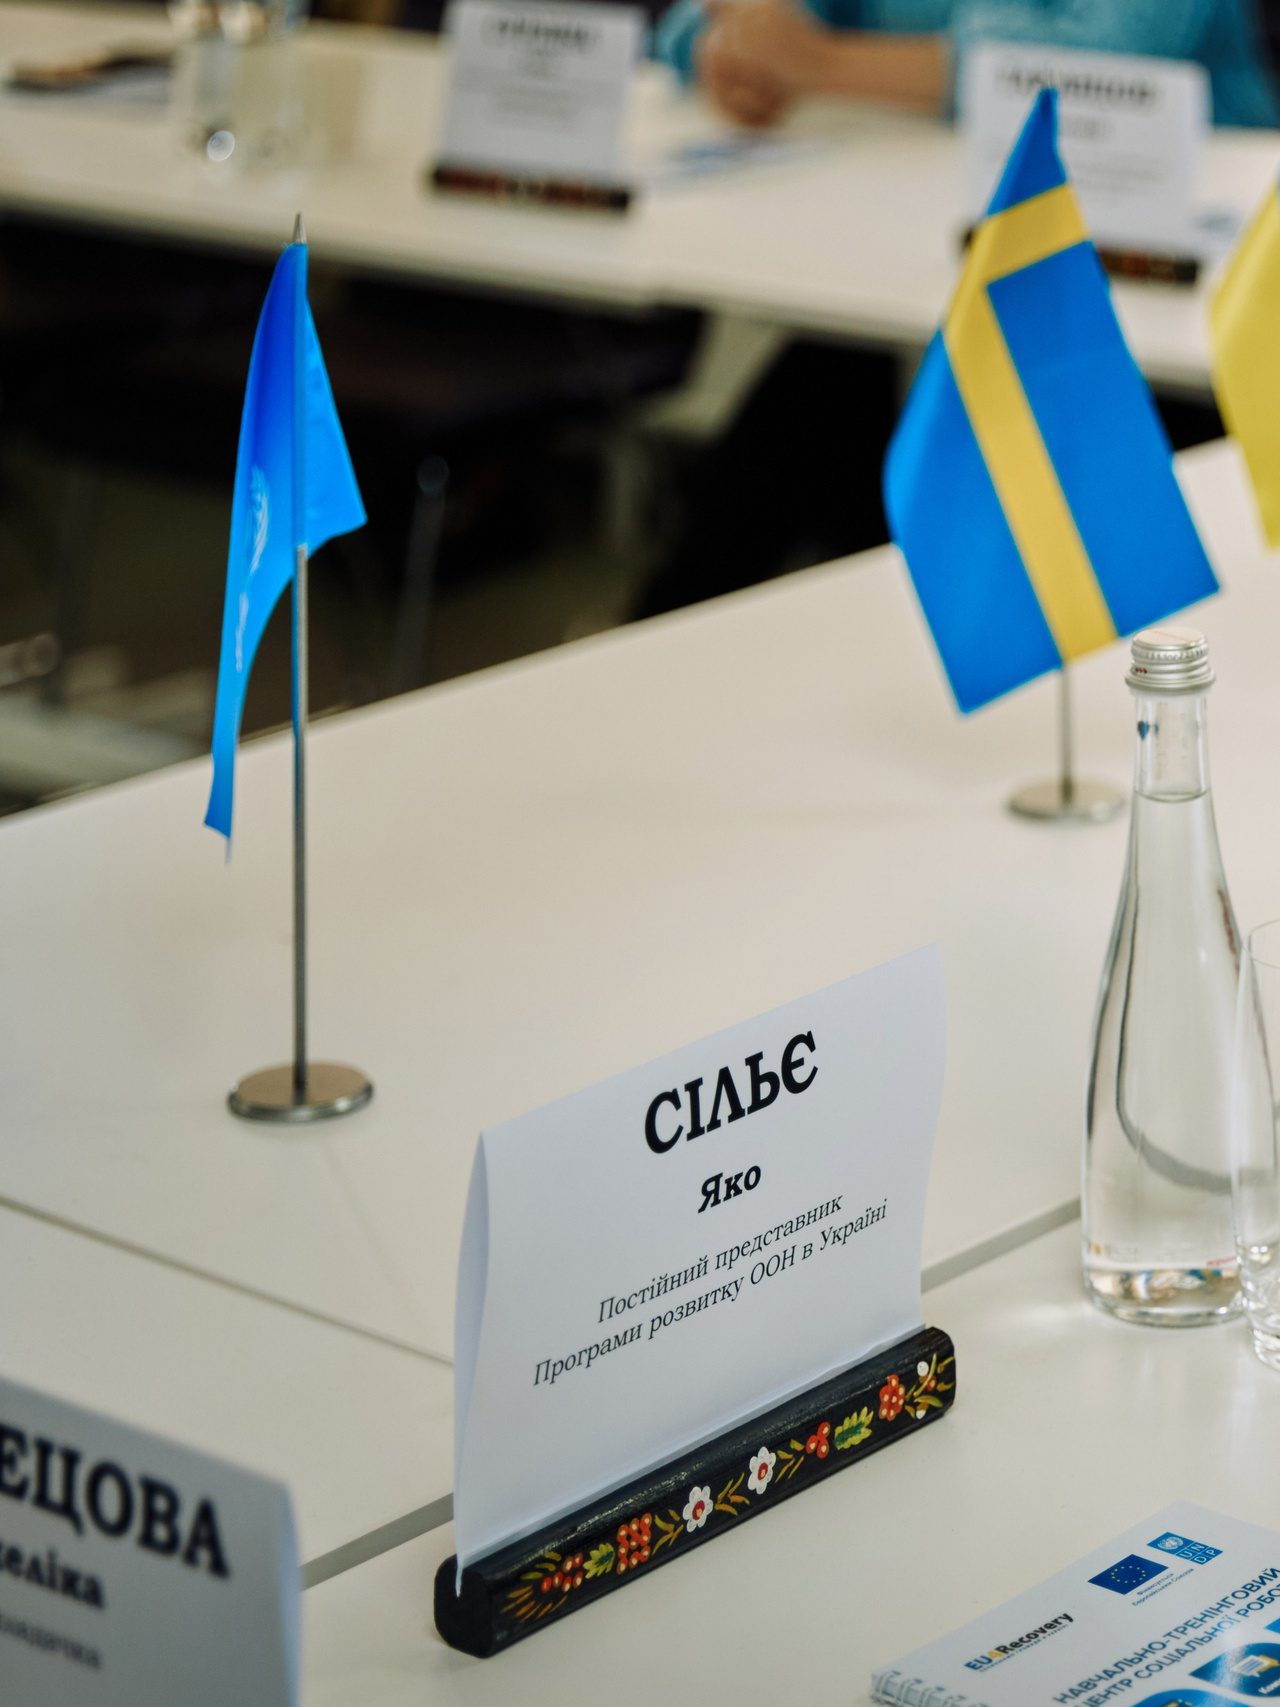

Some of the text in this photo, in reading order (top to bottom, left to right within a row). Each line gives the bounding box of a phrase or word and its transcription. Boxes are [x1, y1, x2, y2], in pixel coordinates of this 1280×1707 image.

[644, 1030, 818, 1154] СІЛЬЄ
[697, 1165, 762, 1214] Яко
[533, 1198, 888, 1386] Програми розвитку ООН в Україні
[598, 1195, 844, 1324] Постійний представник
[0, 1423, 231, 1580] ЕЦОВА
[0, 1538, 106, 1609] еліка
[964, 1612, 1074, 1671] EU4Recovery
[1134, 1614, 1241, 1681] СОЦІАЛЬНОЇ
